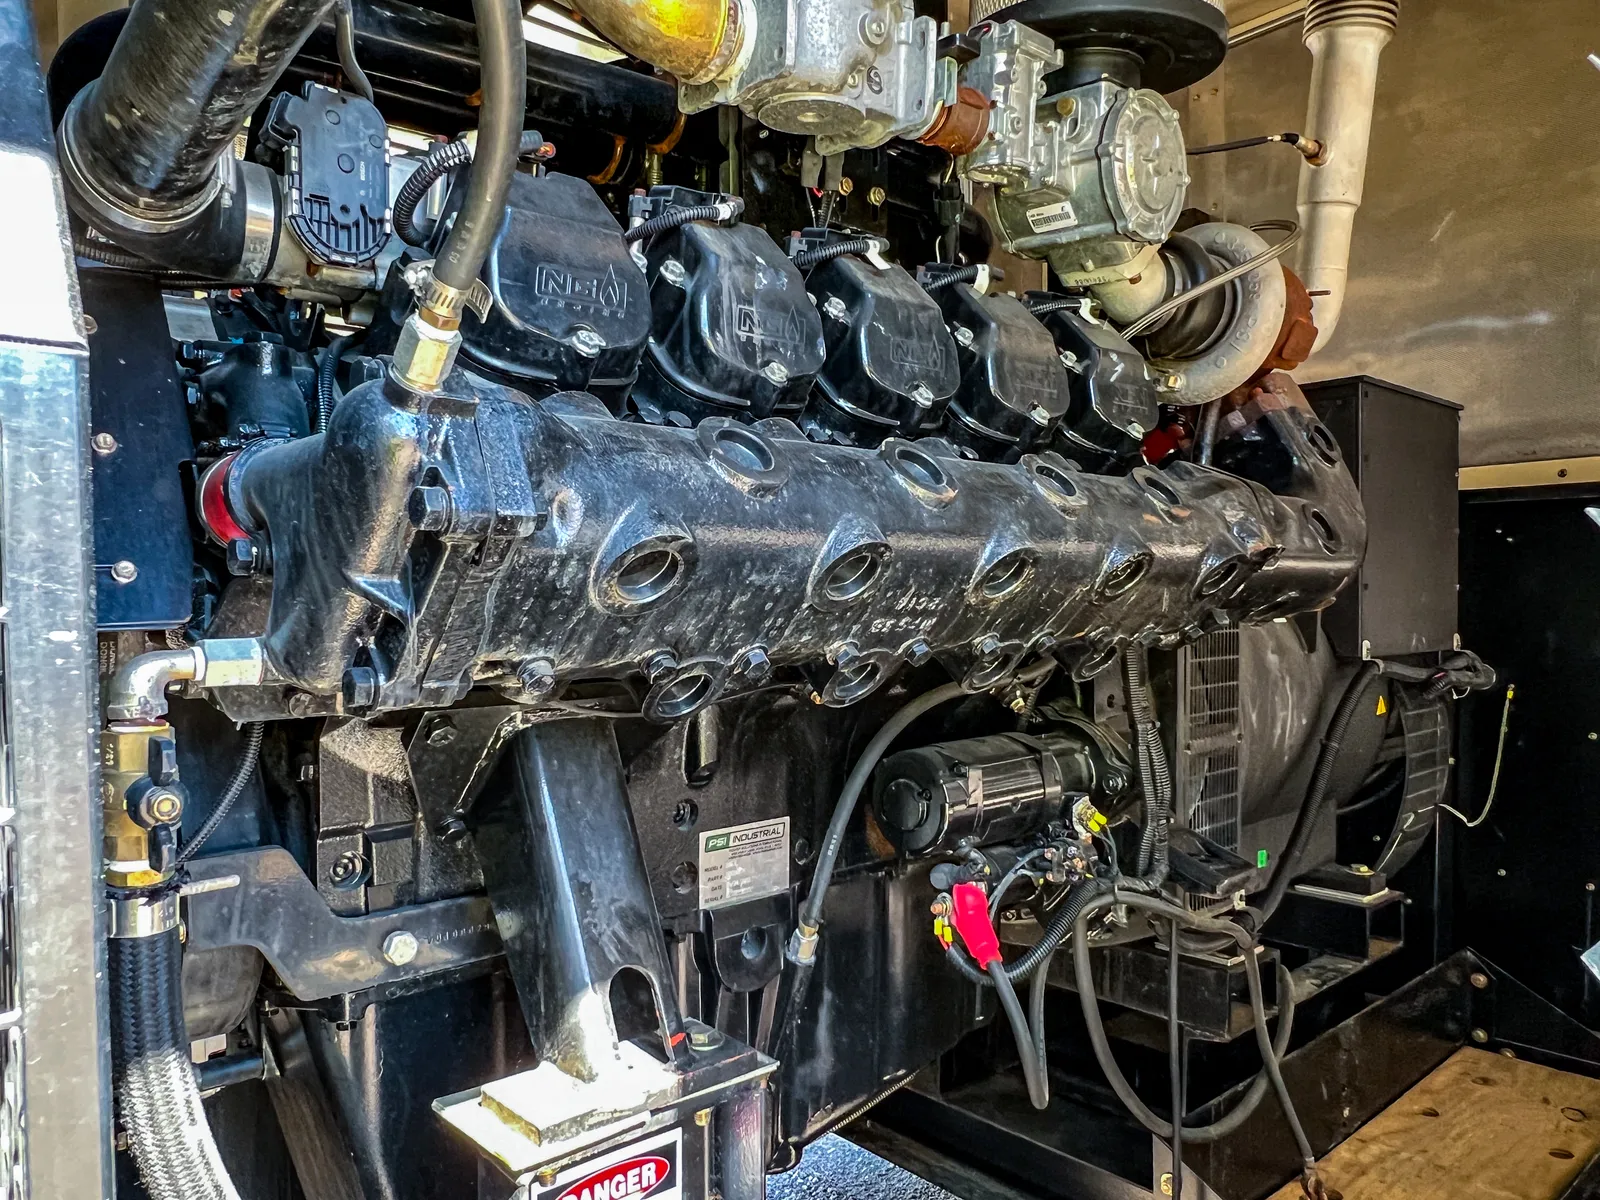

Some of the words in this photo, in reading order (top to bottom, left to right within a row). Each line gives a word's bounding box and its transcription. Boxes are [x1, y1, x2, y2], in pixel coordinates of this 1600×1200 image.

[708, 837, 728, 849] PSI
[732, 827, 781, 844] INDUSTRIAL
[562, 1161, 657, 1200] ANGER
